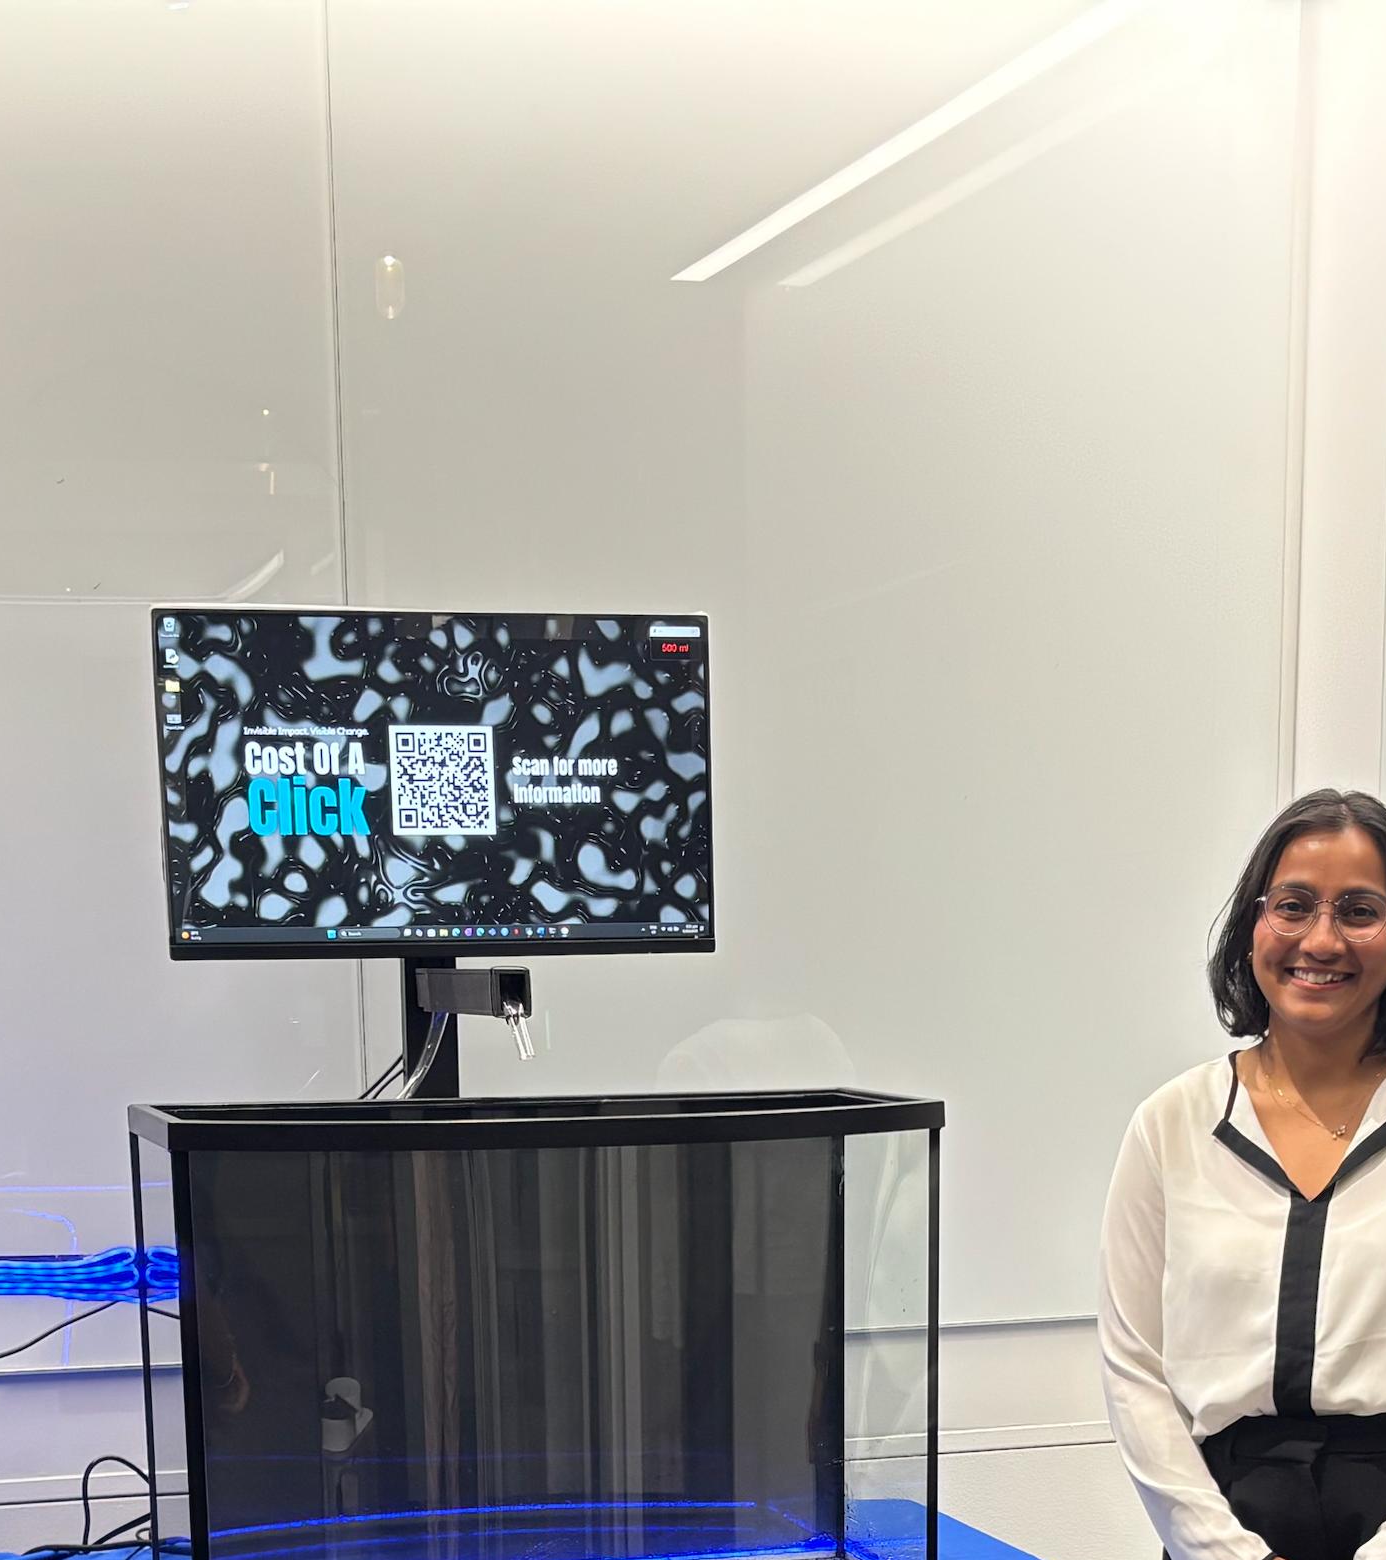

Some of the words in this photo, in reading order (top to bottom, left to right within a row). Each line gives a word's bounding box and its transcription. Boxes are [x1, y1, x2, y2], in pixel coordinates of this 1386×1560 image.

[244, 741, 307, 775] Cost
[313, 741, 340, 775] Of
[348, 742, 366, 775] A
[512, 756, 550, 777] Scan
[552, 755, 575, 777] for
[578, 758, 618, 777] more
[248, 775, 371, 837] Click
